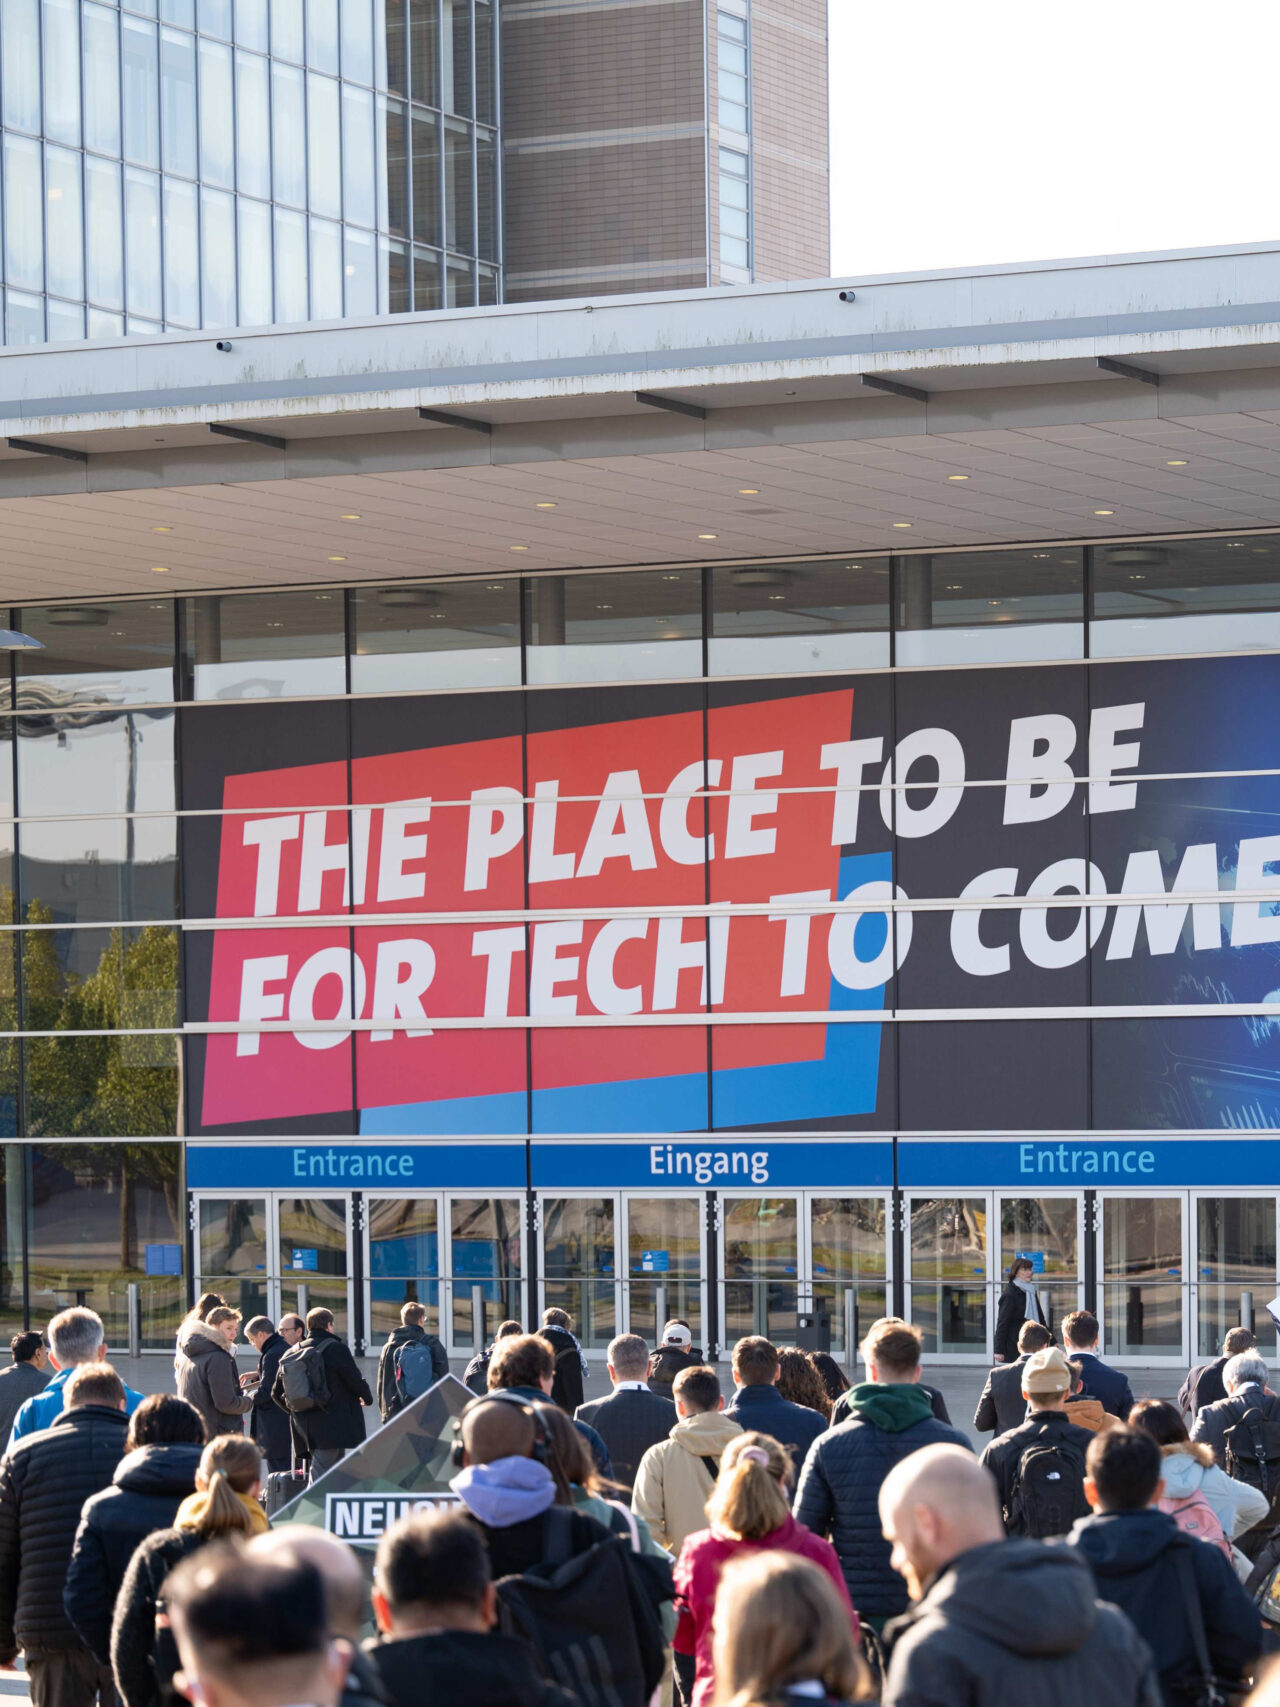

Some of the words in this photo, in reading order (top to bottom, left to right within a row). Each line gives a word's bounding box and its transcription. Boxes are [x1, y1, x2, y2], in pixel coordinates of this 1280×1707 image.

[242, 797, 432, 918] THE
[463, 750, 784, 892] PLACE
[819, 727, 966, 846] TO
[1002, 702, 1146, 825] BE
[236, 938, 438, 1057] FOR
[471, 901, 732, 1028] TECH
[768, 880, 913, 991] TO
[292, 1148, 414, 1177] Entrance
[650, 1145, 769, 1184] Eingang
[1019, 1143, 1156, 1173] Entrance
